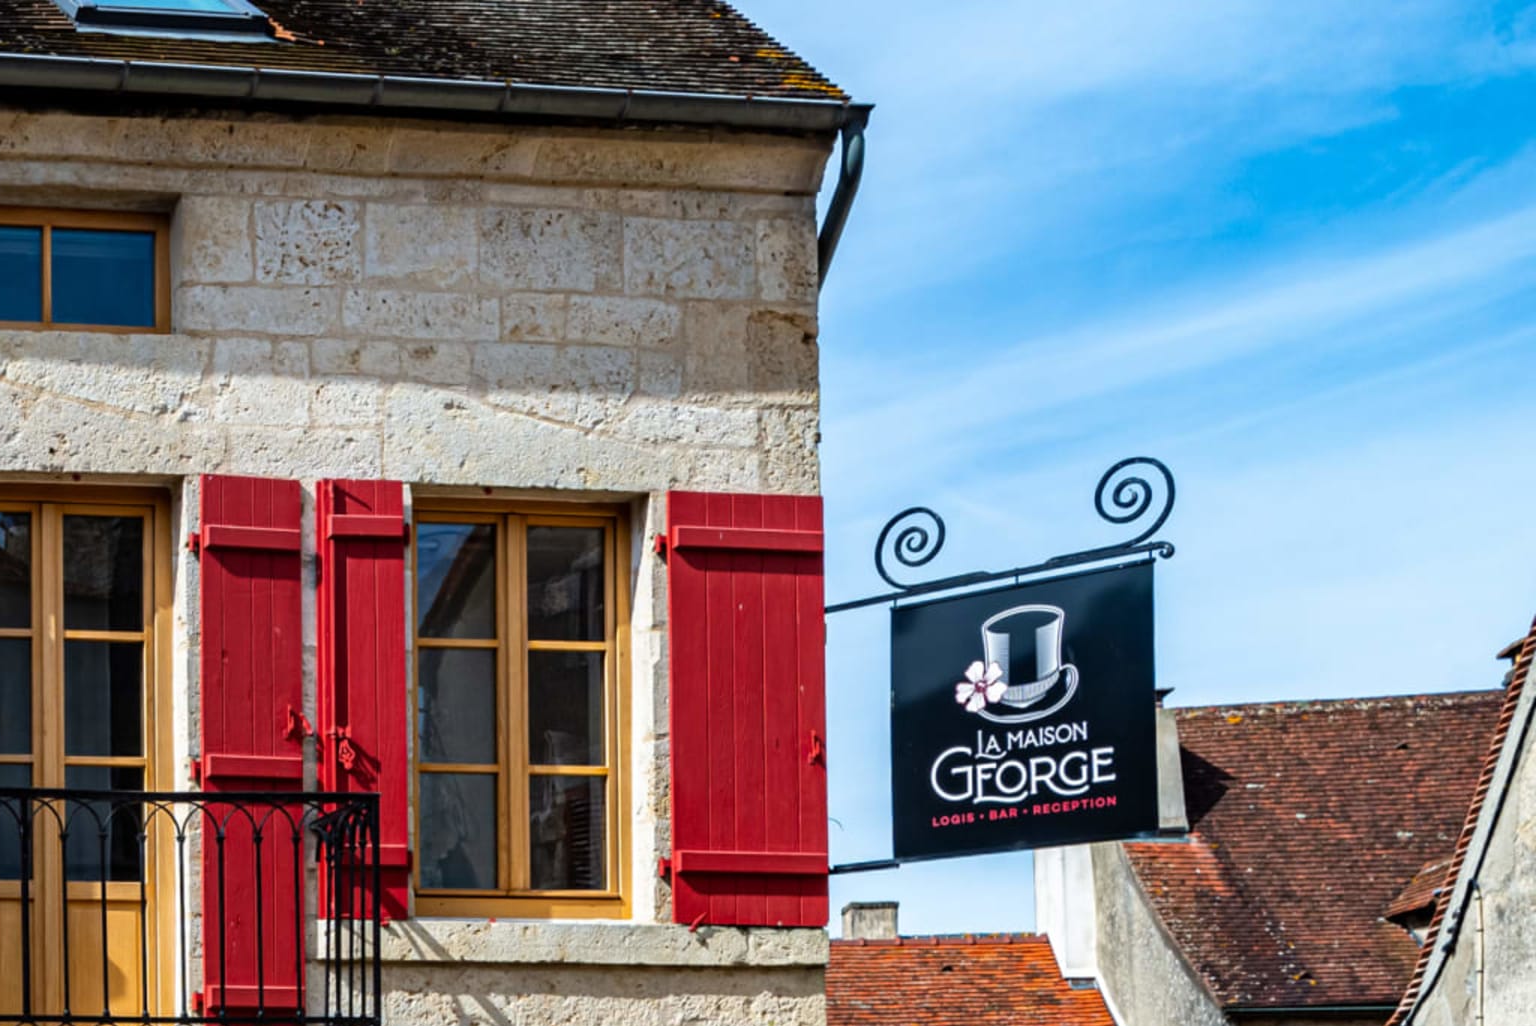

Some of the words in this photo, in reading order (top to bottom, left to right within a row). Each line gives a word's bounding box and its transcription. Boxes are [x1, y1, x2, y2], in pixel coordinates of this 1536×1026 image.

[975, 729, 1007, 759] LA
[1007, 721, 1088, 750] MAISON
[930, 746, 1116, 804] GEORGE
[931, 812, 975, 827] LOGIS
[988, 808, 1018, 820] BAR
[1032, 795, 1117, 815] RECEPTION
